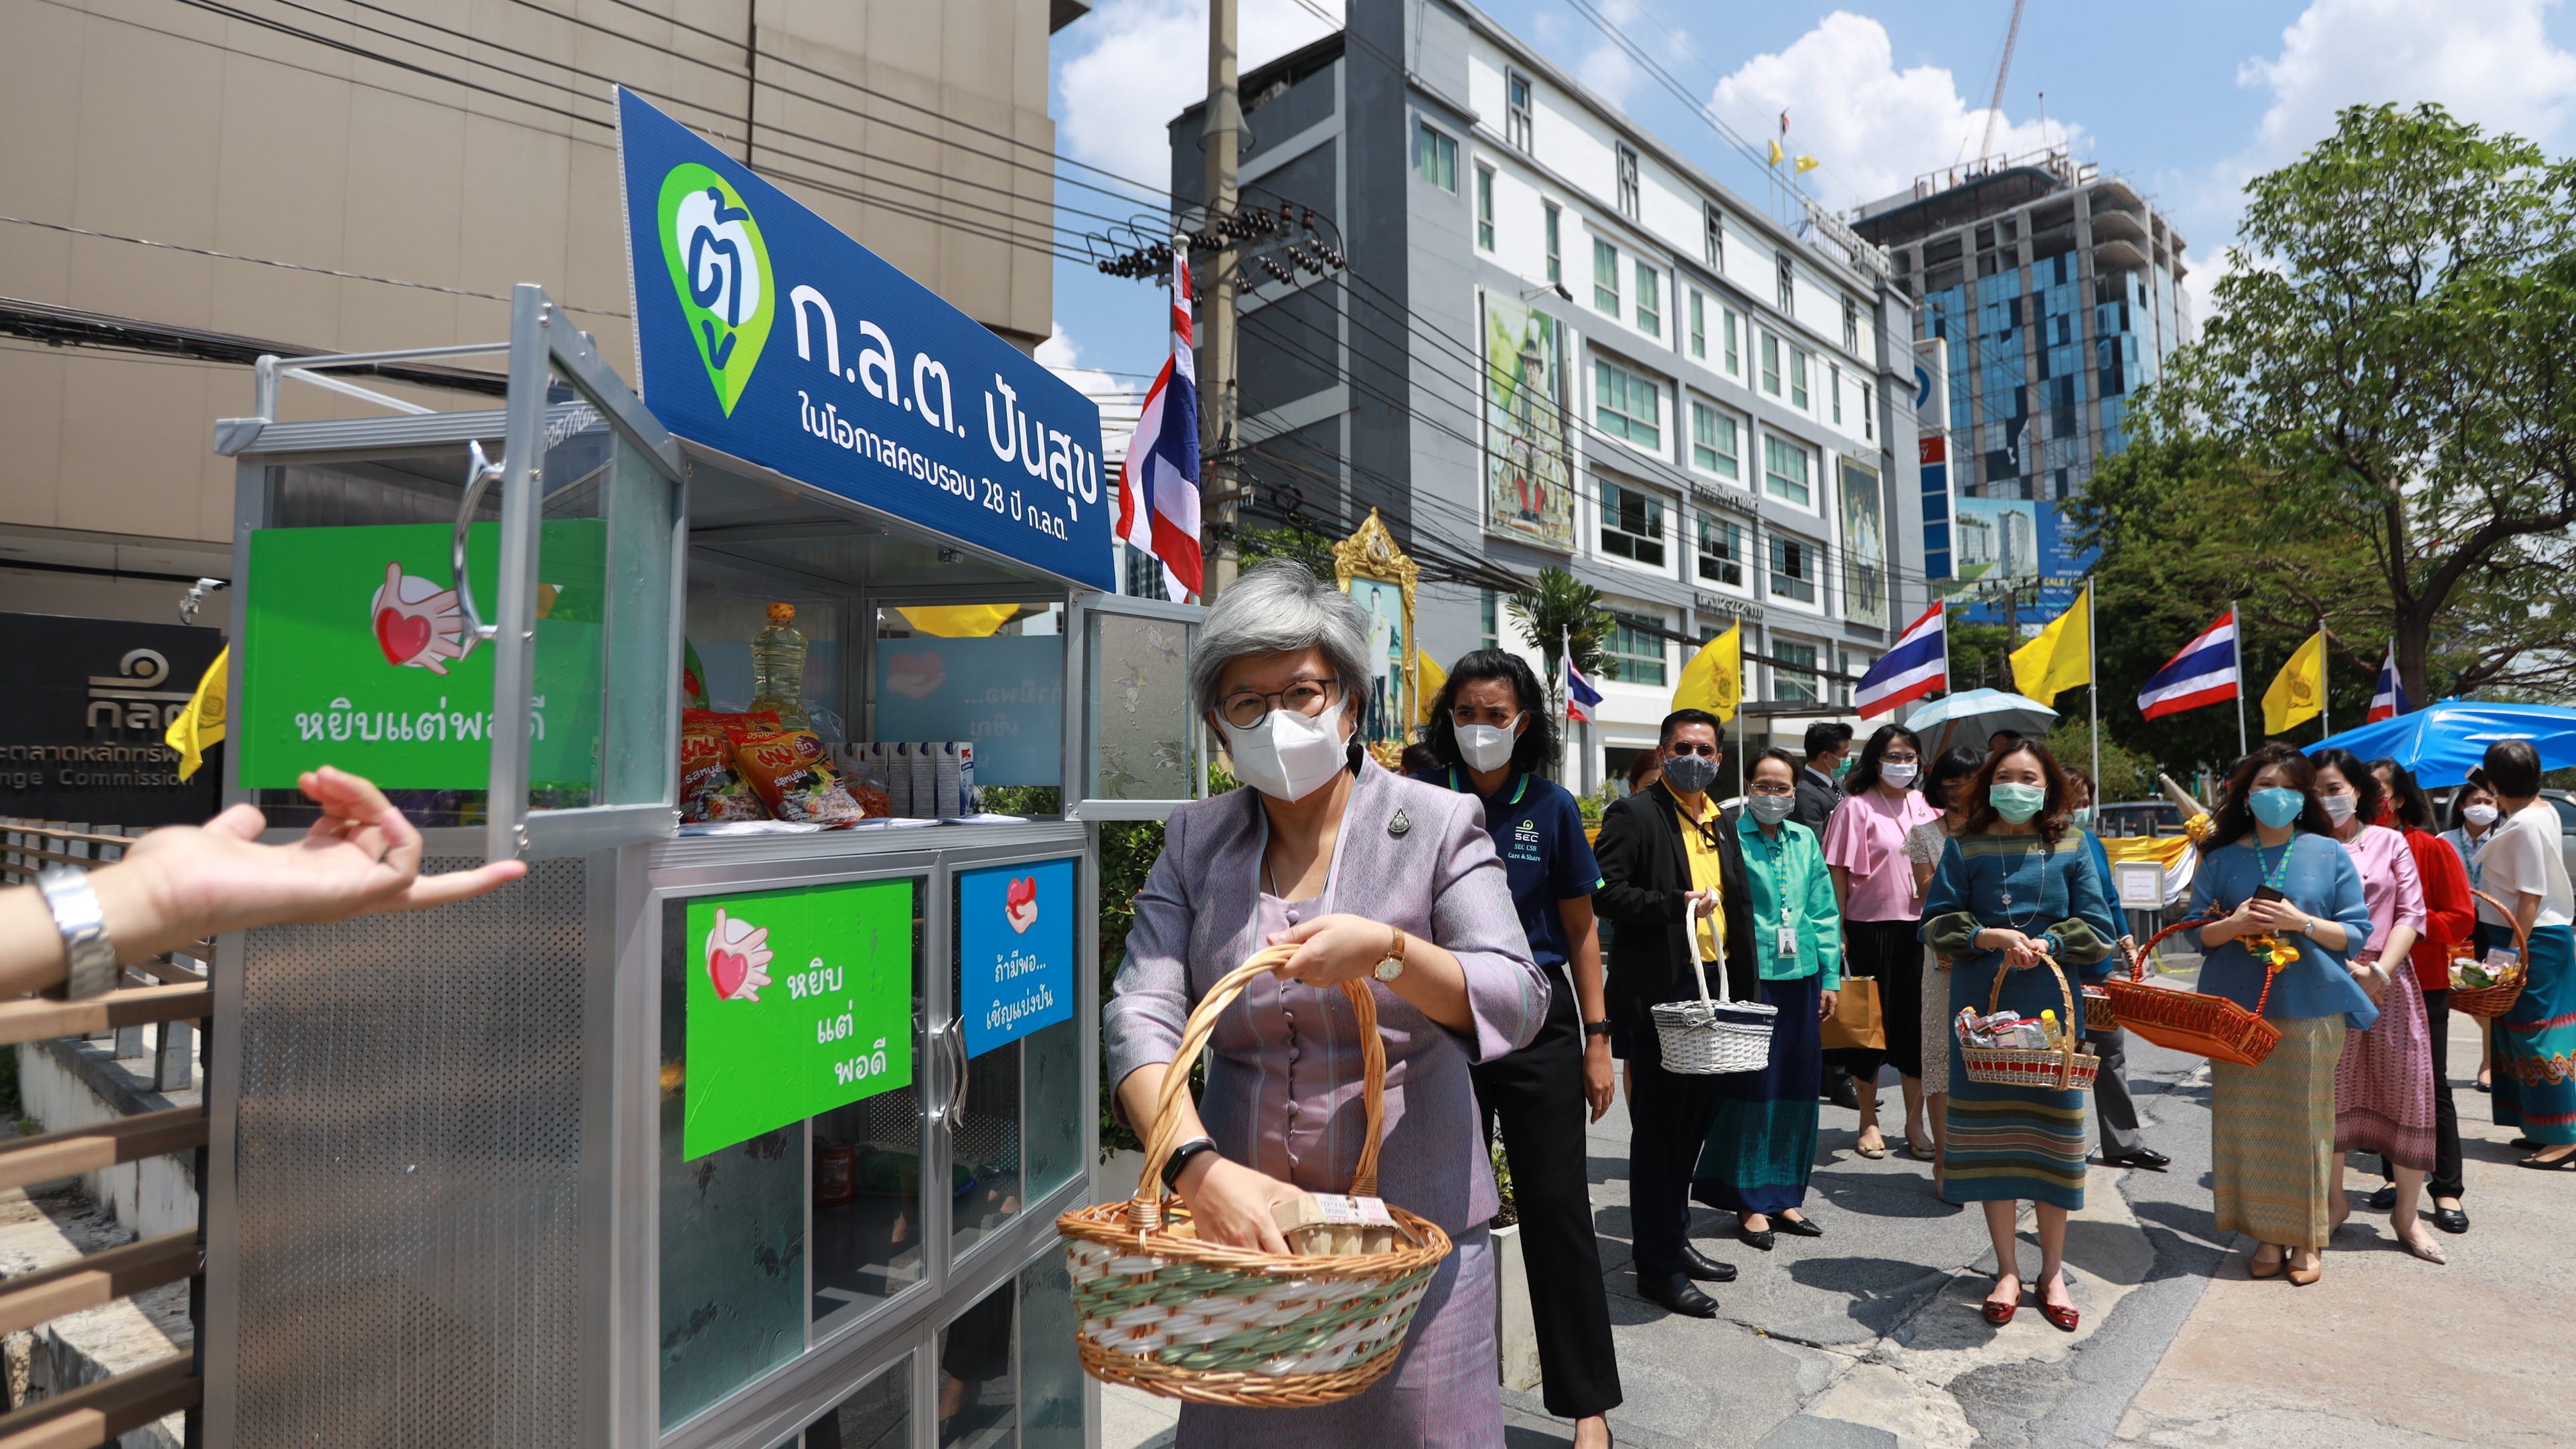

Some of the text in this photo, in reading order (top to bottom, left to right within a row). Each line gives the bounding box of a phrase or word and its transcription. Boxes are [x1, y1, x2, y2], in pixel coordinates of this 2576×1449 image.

[790, 285, 965, 439] ก.ล.ต.
[984, 372, 1098, 522] ปันสุข
[798, 390, 1068, 541] ในโอกาสครบรอบ 28 ปี ก.ล.ต.
[0, 741, 179, 763] ะตลาดหลักทรัพ
[1514, 833, 1538, 842] SEC
[787, 957, 843, 1000] หยิบ
[994, 950, 1047, 984] ถ้ามีพอ...
[817, 999, 854, 1044] แต่
[986, 984, 1054, 1031] เชิญแบ่งปัน
[834, 1037, 888, 1086] พอดี
[1320, 1201, 1347, 1209] CERTIFIED
[1324, 1207, 1348, 1215] ORGANIC
